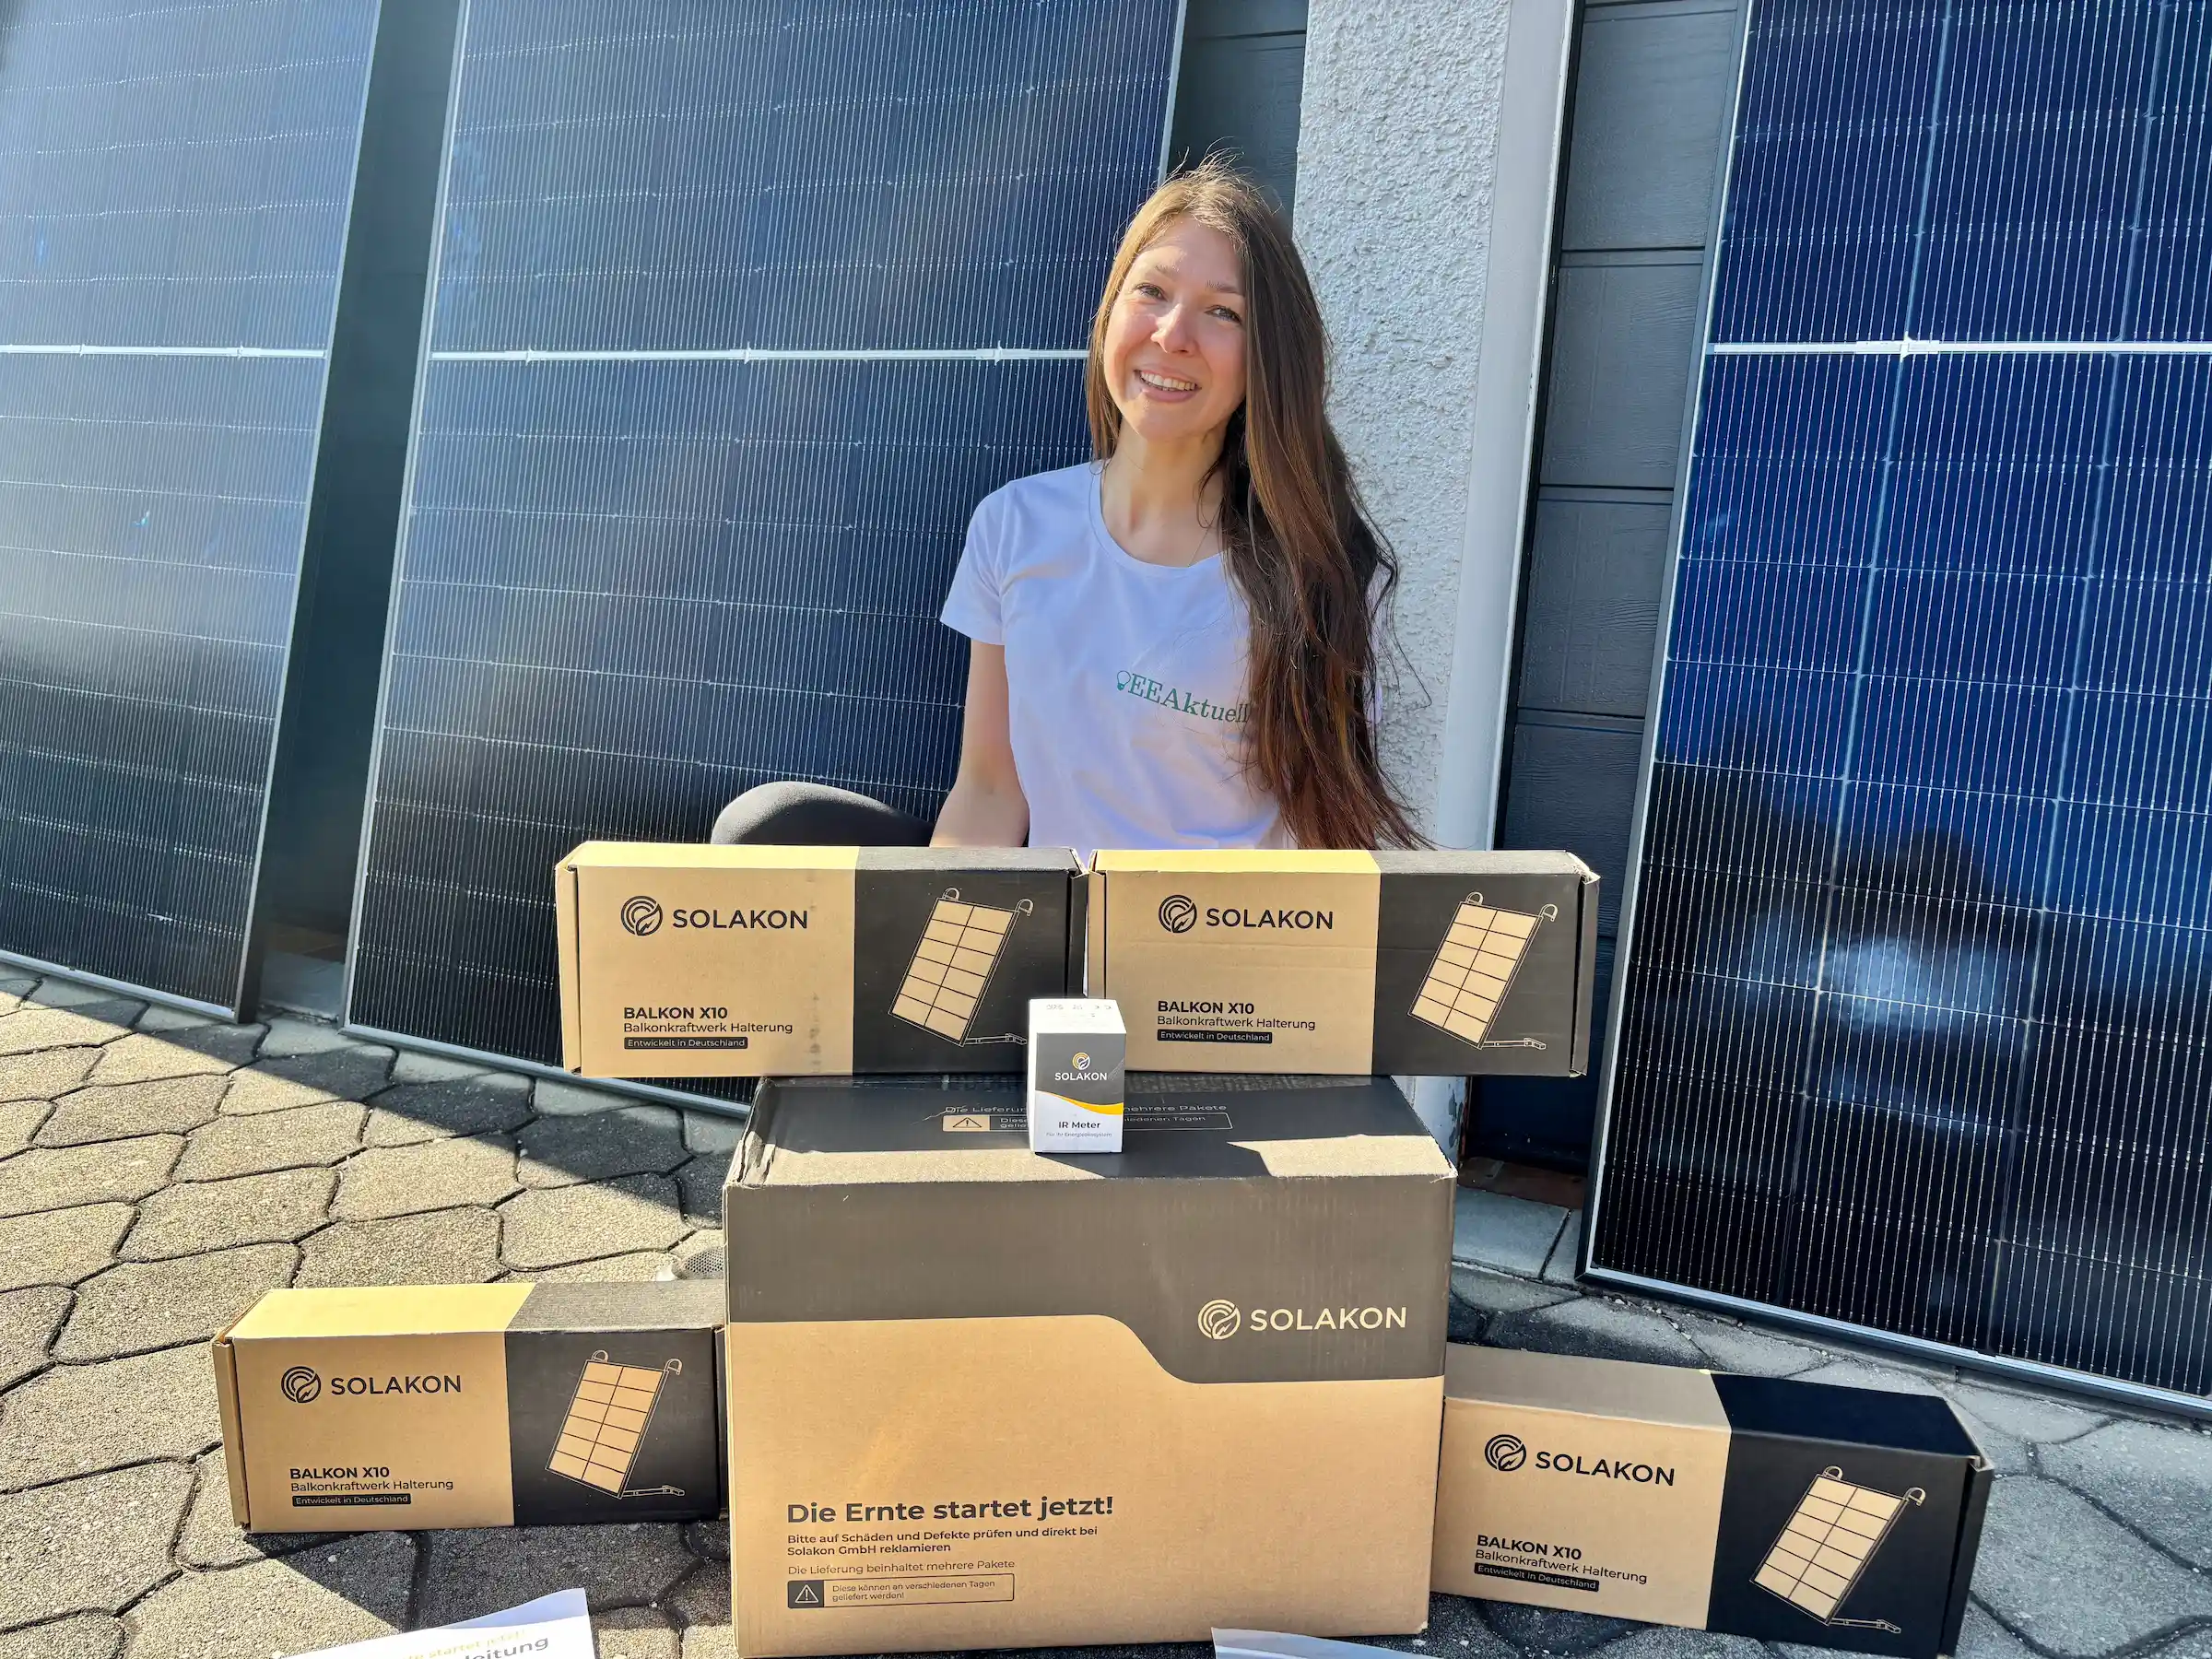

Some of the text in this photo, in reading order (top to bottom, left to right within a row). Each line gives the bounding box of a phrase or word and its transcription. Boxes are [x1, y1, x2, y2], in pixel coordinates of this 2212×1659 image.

[672, 908, 808, 930] SOLAKON
[1206, 907, 1334, 930] SOLAKON
[623, 1006, 728, 1020] BALKON X10
[1158, 1000, 1254, 1015] BALKON X10
[623, 1021, 793, 1035] Balkonkraftwerk Halterung
[1157, 1015, 1316, 1031] Balkonkraftwerk Halterung
[628, 1038, 746, 1048] Entwickelt in Deutschland
[1160, 1030, 1271, 1043] Entwickelt in Deutschland
[1054, 1072, 1108, 1081] SOLAKON
[1058, 1121, 1101, 1129] IR Meter
[1249, 1306, 1407, 1332] SOLAKON
[331, 1374, 462, 1396] SOLAKON
[289, 1465, 390, 1480] BALKON X10
[1535, 1451, 1676, 1487] SOLAKON
[290, 1478, 453, 1492] Balkonkraftwerk Halterung
[295, 1494, 409, 1506] Entwickelt in Deutschland
[787, 1496, 1114, 1524] Die Ernte startet jetzt!
[787, 1525, 1098, 1544] Bitte auf Schäden und Defekte prüfen und direkt bei
[787, 1543, 951, 1556] Solakon GmbH reklamieren
[1477, 1535, 1583, 1560] BALKON X10
[788, 1559, 1016, 1576] Die Lieferung beinhaltet mehrere Pakete
[1476, 1549, 1648, 1585] Balkonkraftwerk Halterung
[1477, 1565, 1596, 1590] Entwickelt in Deutschland
[832, 1583, 856, 1593] Diese
[858, 1583, 891, 1592] können
[906, 1581, 968, 1590] verschiedenen
[970, 1580, 995, 1590] Tagen
[832, 1592, 905, 1603] geliefert werden!
